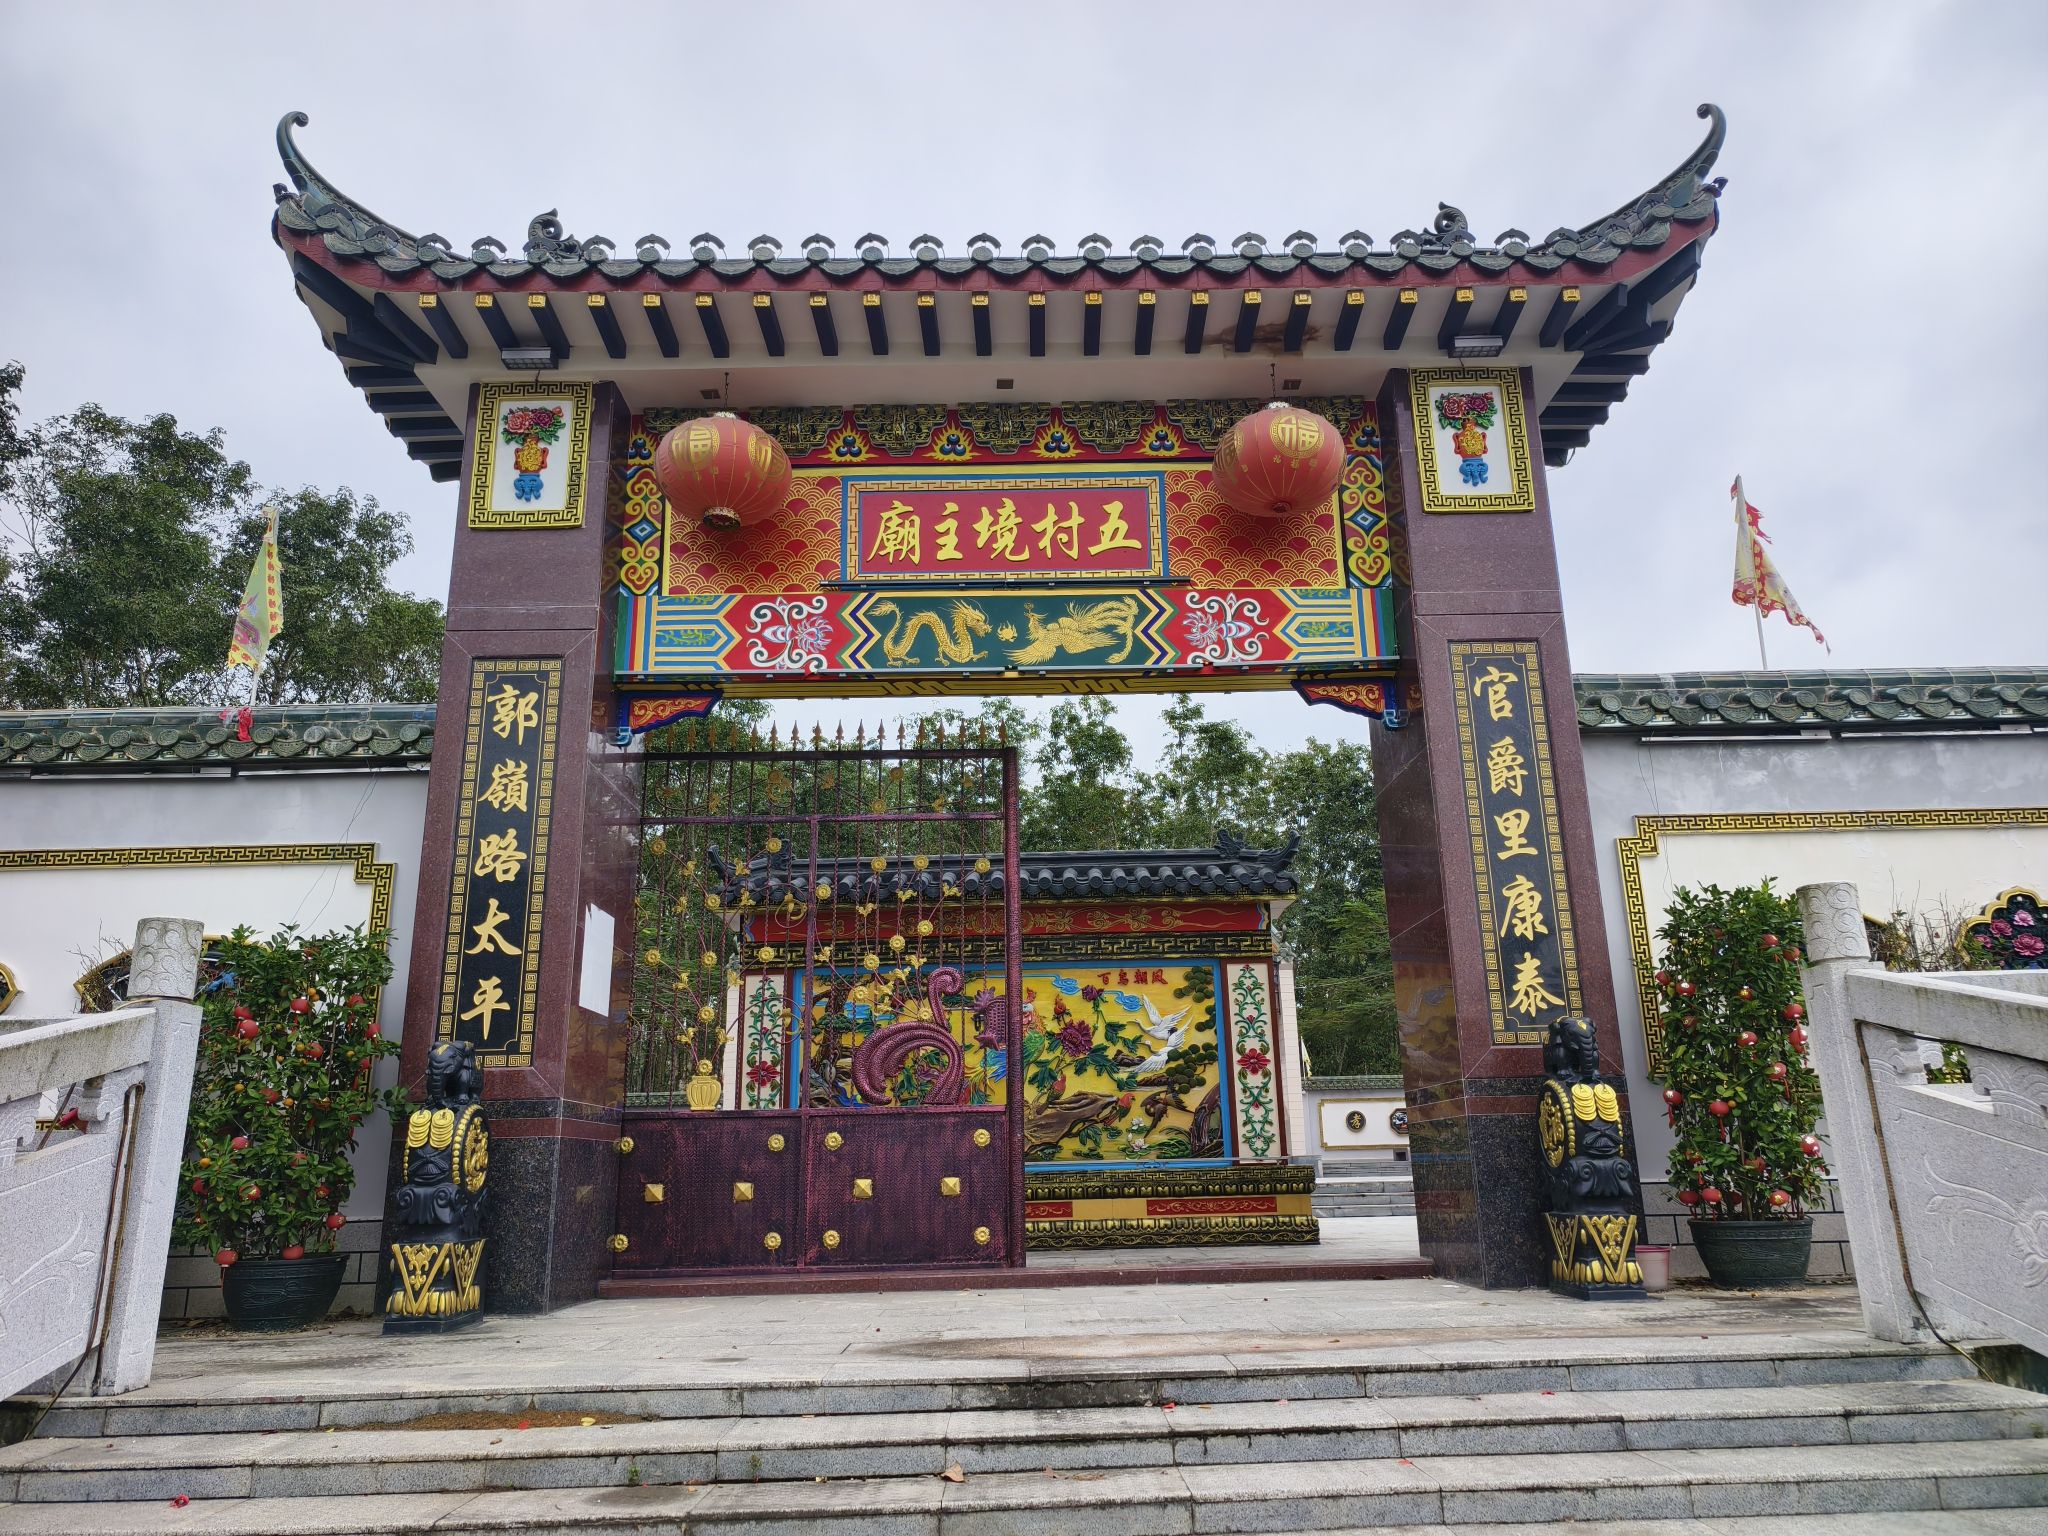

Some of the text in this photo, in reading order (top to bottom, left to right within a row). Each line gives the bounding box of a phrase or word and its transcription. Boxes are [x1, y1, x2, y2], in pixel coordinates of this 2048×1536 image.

[461, 684, 538, 1040] 郭嶺路太平
[1474, 666, 1565, 1018] 官爵里康泰
